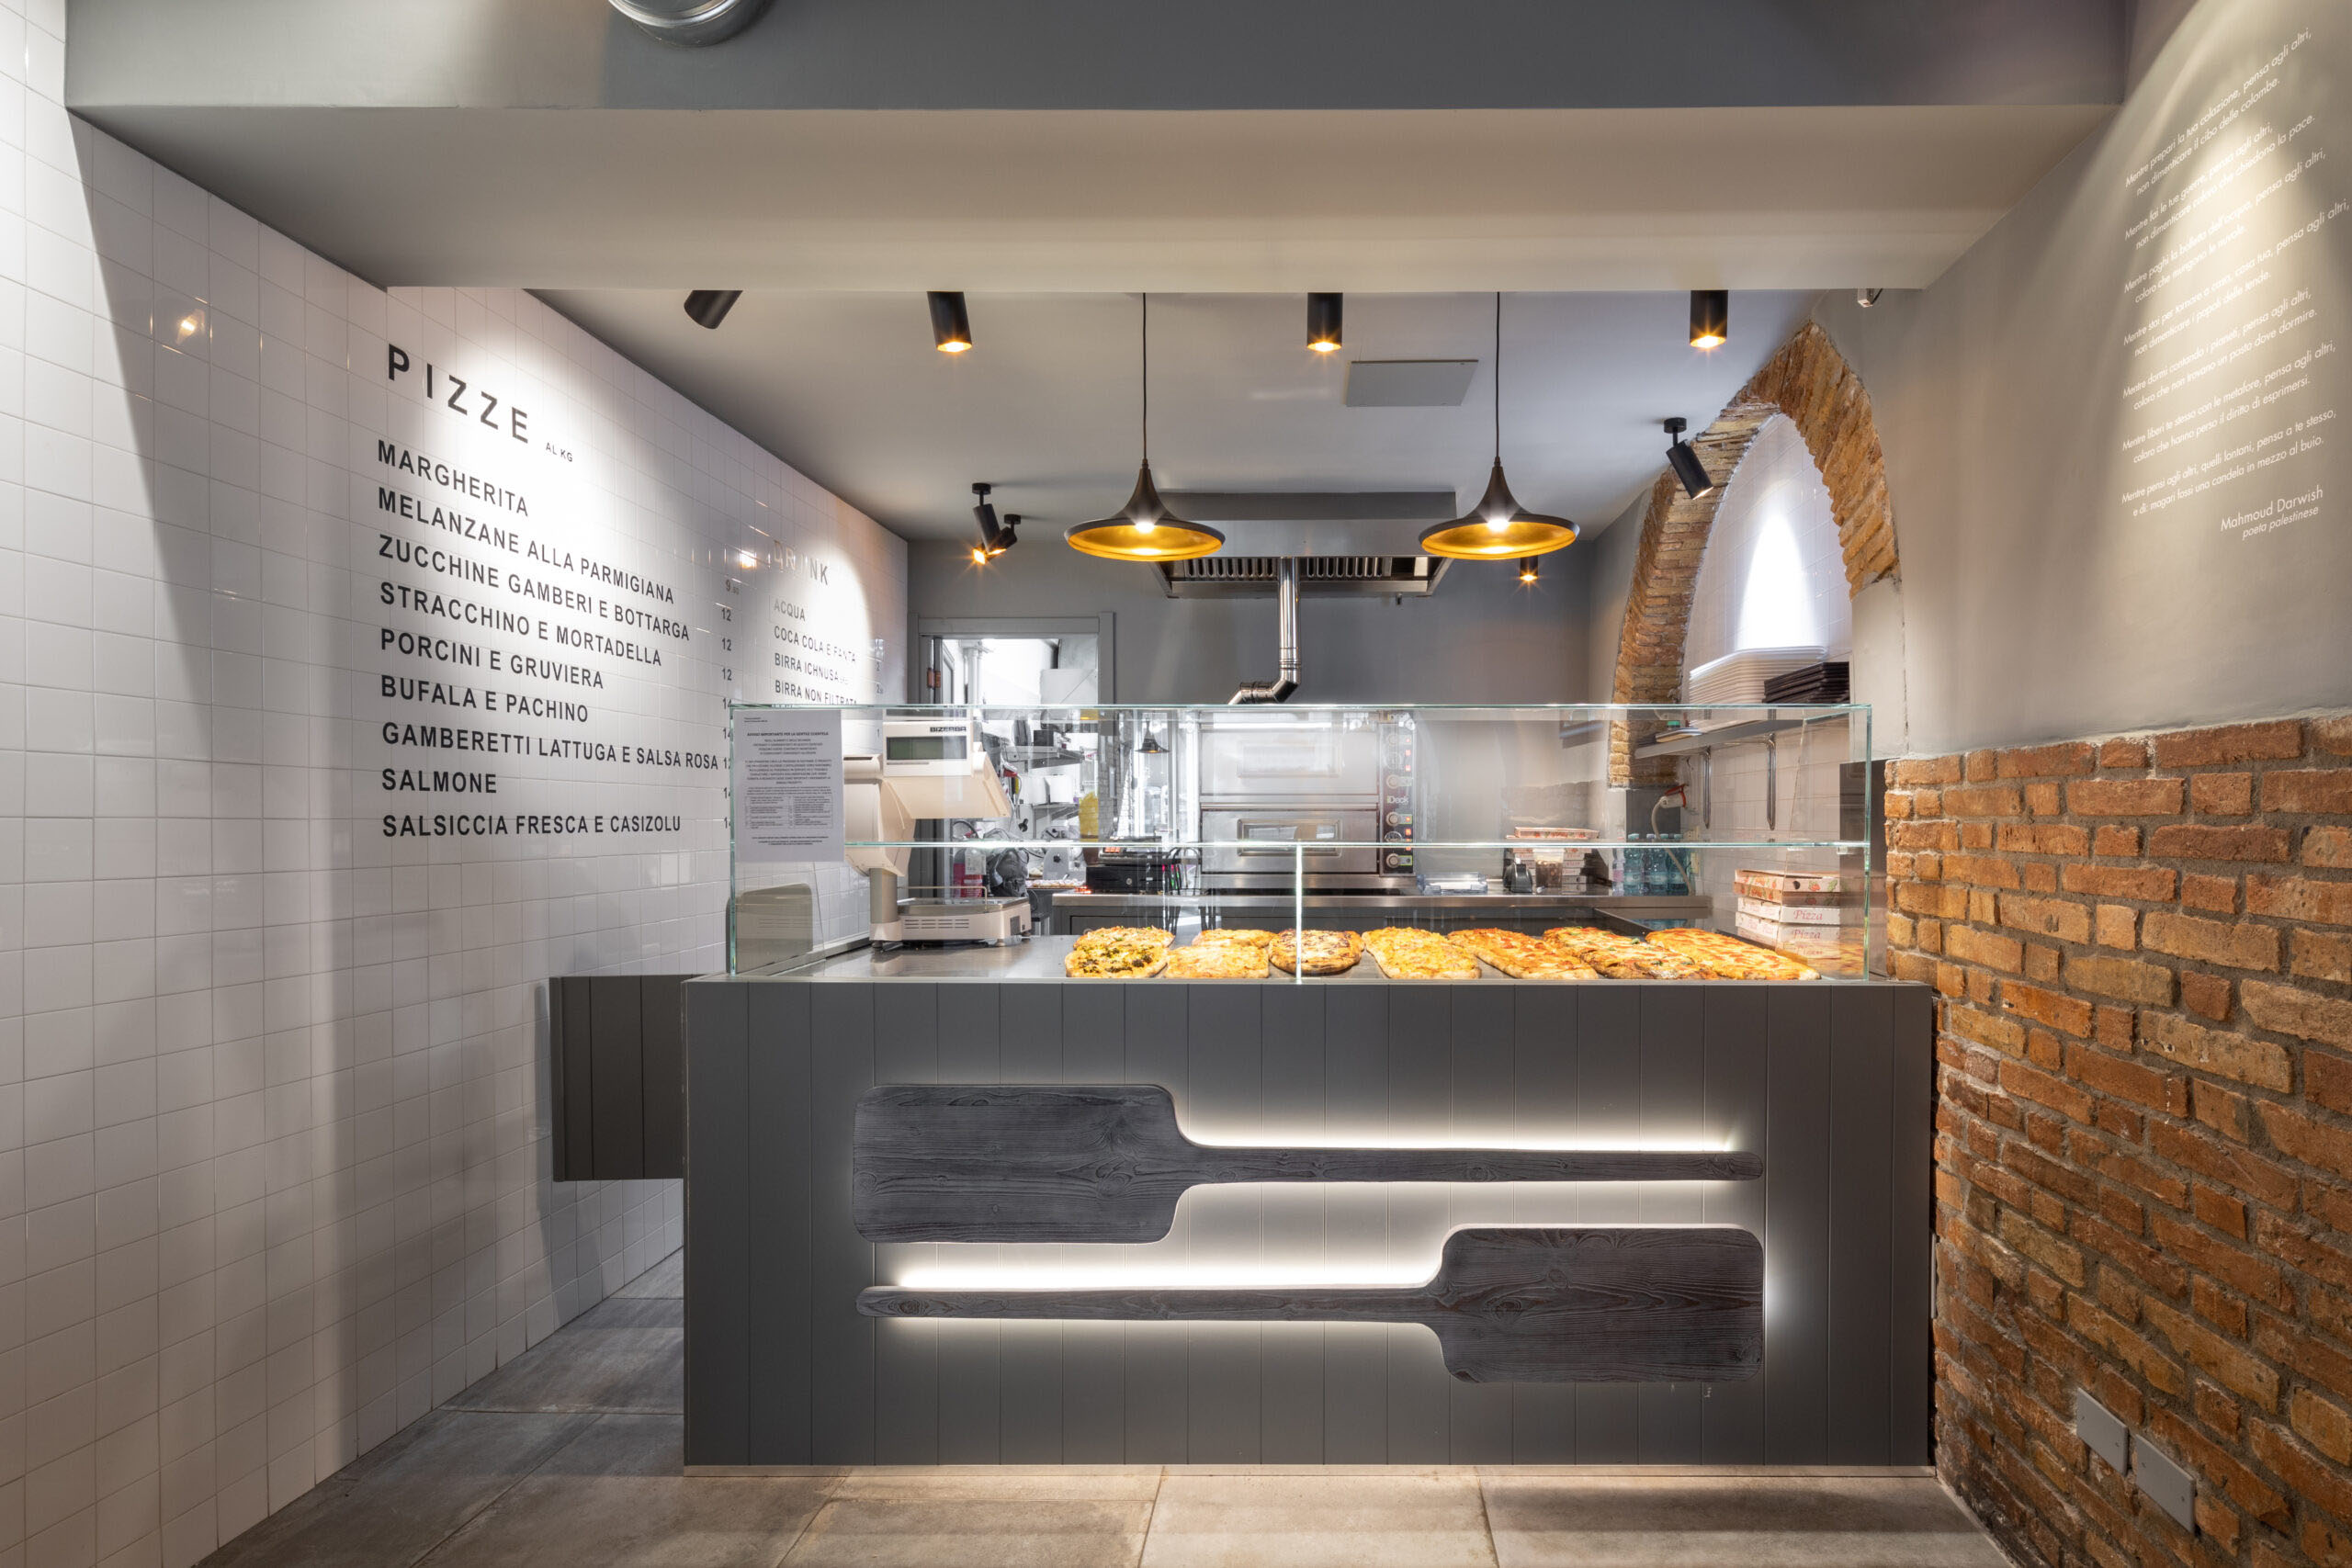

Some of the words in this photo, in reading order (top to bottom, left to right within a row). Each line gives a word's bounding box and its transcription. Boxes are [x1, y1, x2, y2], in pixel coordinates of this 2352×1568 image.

[2124, 164, 2148, 187] Mentre
[2150, 140, 2176, 169] prepari
[2177, 134, 2185, 144] la
[2187, 123, 2198, 138] tua
[2199, 90, 2240, 125] colazione,
[2243, 64, 2268, 93] pensa
[2271, 44, 2288, 66] agli
[2290, 28, 2312, 51] altri,
[2136, 182, 2149, 196] non
[2151, 148, 2192, 184] dimenticare
[2199, 127, 2217, 144] cibo
[2219, 110, 2238, 129] delle
[2240, 78, 2279, 112] colombe.
[2124, 219, 2147, 240] Mentre
[2149, 207, 2158, 221] fai
[2167, 195, 2178, 207] tue
[2254, 122, 2272, 142] altri,
[2135, 236, 2148, 250] non
[2150, 205, 2191, 239] dimenticare
[2278, 134, 2286, 146] la
[2289, 115, 2315, 141] pace.
[2123, 273, 2147, 293] Mentre
[2149, 254, 2168, 277] paghi
[2256, 179, 2281, 206] pensa
[2284, 162, 2301, 182] agli
[2304, 148, 2325, 168] altri,
[2122, 327, 2146, 345] Mentre
[2276, 229, 2303, 255] pensa
[2306, 212, 2324, 232] agli
[2327, 198, 2349, 219] altri,
[2134, 285, 2156, 303] coloro
[2122, 381, 2146, 399] Mentre
[2147, 366, 2167, 384] dormi
[2243, 313, 2268, 336] pensa
[2270, 299, 2289, 317] agli
[2290, 288, 2312, 306] altri,
[2132, 394, 2154, 410] coloro
[2156, 387, 2168, 398] che
[2170, 378, 2185, 390] non
[2216, 355, 2227, 366] un
[2229, 343, 2252, 363] posto
[2254, 330, 2276, 346] dove
[2278, 310, 2317, 333] dormire.
[2134, 344, 2147, 356] non
[388, 344, 528, 444] PIZZE
[546, 442, 557, 455] AL
[560, 449, 572, 462] KG
[2121, 435, 2145, 451] Mentre
[2146, 424, 2164, 439] liberi
[2165, 422, 2173, 430] te
[2222, 379, 2261, 401] metafore,
[2264, 364, 2291, 386] pensa
[2293, 350, 2312, 368] agli
[2314, 340, 2335, 358] altri,
[2132, 448, 2154, 463] coloro
[2155, 442, 2168, 453] che
[2170, 431, 2194, 446] hanno
[2196, 420, 2217, 438] perso
[2251, 396, 2260, 409] di
[2262, 375, 2310, 404] esprimersi.
[378, 439, 528, 517] MARGHERITA
[2121, 489, 2145, 503] Mentre
[2146, 480, 2165, 495] pensi
[2200, 454, 2222, 472] quelli
[2222, 441, 2254, 461] lontani,
[2256, 431, 2283, 451] pensa
[2294, 422, 2303, 432] te
[2306, 410, 2336, 427] stesso,
[2150, 495, 2176, 510] magari
[2195, 481, 2210, 492] una
[2211, 467, 2244, 485] candela
[2246, 462, 2255, 473] in
[2256, 451, 2286, 468] mezzo
[2289, 443, 2297, 456] al
[2300, 436, 2324, 451] buio.
[2220, 502, 2273, 531] Mahmoud
[2276, 484, 2323, 512] Darwish
[2242, 524, 2266, 540] poeta
[2268, 507, 2318, 532] palestinese
[378, 488, 519, 554] MELANZANE
[527, 540, 574, 572] ALLA
[581, 558, 674, 604] PARMIGIANA
[721, 607, 732, 622] 12
[379, 534, 499, 588] ZUCCHINE
[508, 573, 593, 615] GAMBERI
[599, 600, 608, 618] E
[615, 604, 690, 641] BOTTARGA
[721, 637, 732, 651] 12
[379, 581, 530, 637] STRACCHINO
[538, 621, 548, 640] E
[556, 625, 662, 667] MORTADELLA
[722, 668, 732, 682] 12
[775, 598, 805, 621] ACQUA
[775, 626, 799, 646] COCA
[802, 636, 823, 652] COLA
[827, 644, 831, 656] E
[381, 628, 481, 668] PORCINI
[490, 650, 501, 671] E
[510, 655, 605, 690] GRUVIERA
[775, 653, 802, 672] BIRRA
[805, 661, 838, 681] ICHNUSA
[775, 680, 802, 698] BIRRA
[806, 689, 822, 703] NON
[825, 693, 856, 705] FILTRAT
[381, 675, 477, 709] BUFALA
[485, 691, 497, 711] E
[506, 694, 589, 723] PACHINO
[381, 768, 497, 794] SALMONE
[382, 721, 531, 755] GAMBERETTI
[538, 737, 616, 763] LATTUGA
[622, 746, 631, 763] E
[636, 748, 682, 768] SALSA
[685, 752, 718, 771] ROSA
[382, 815, 508, 838] SALSICCIA
[515, 815, 589, 834] FRESCA
[594, 816, 604, 833] E
[610, 816, 682, 833] CASIZOLU
[1793, 910, 1823, 921] Pizza
